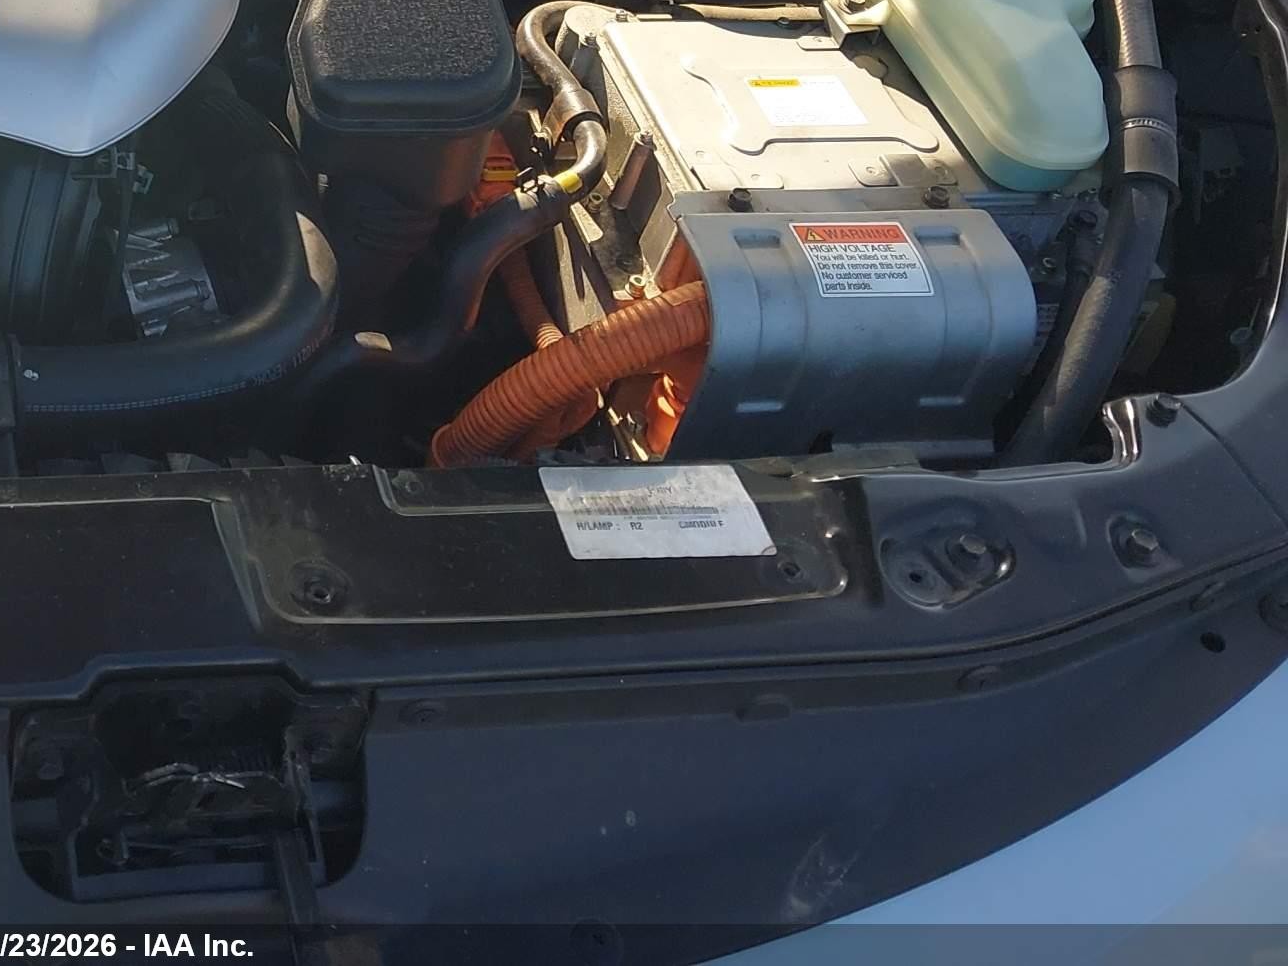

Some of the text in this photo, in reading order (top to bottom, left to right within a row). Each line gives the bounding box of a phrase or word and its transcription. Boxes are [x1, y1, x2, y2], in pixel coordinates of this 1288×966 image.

[823, 228, 900, 239] WARNING
[808, 244, 896, 253] HIGH VOLTAGE
[822, 271, 908, 280] No customer serviced
[825, 282, 846, 291] parts
